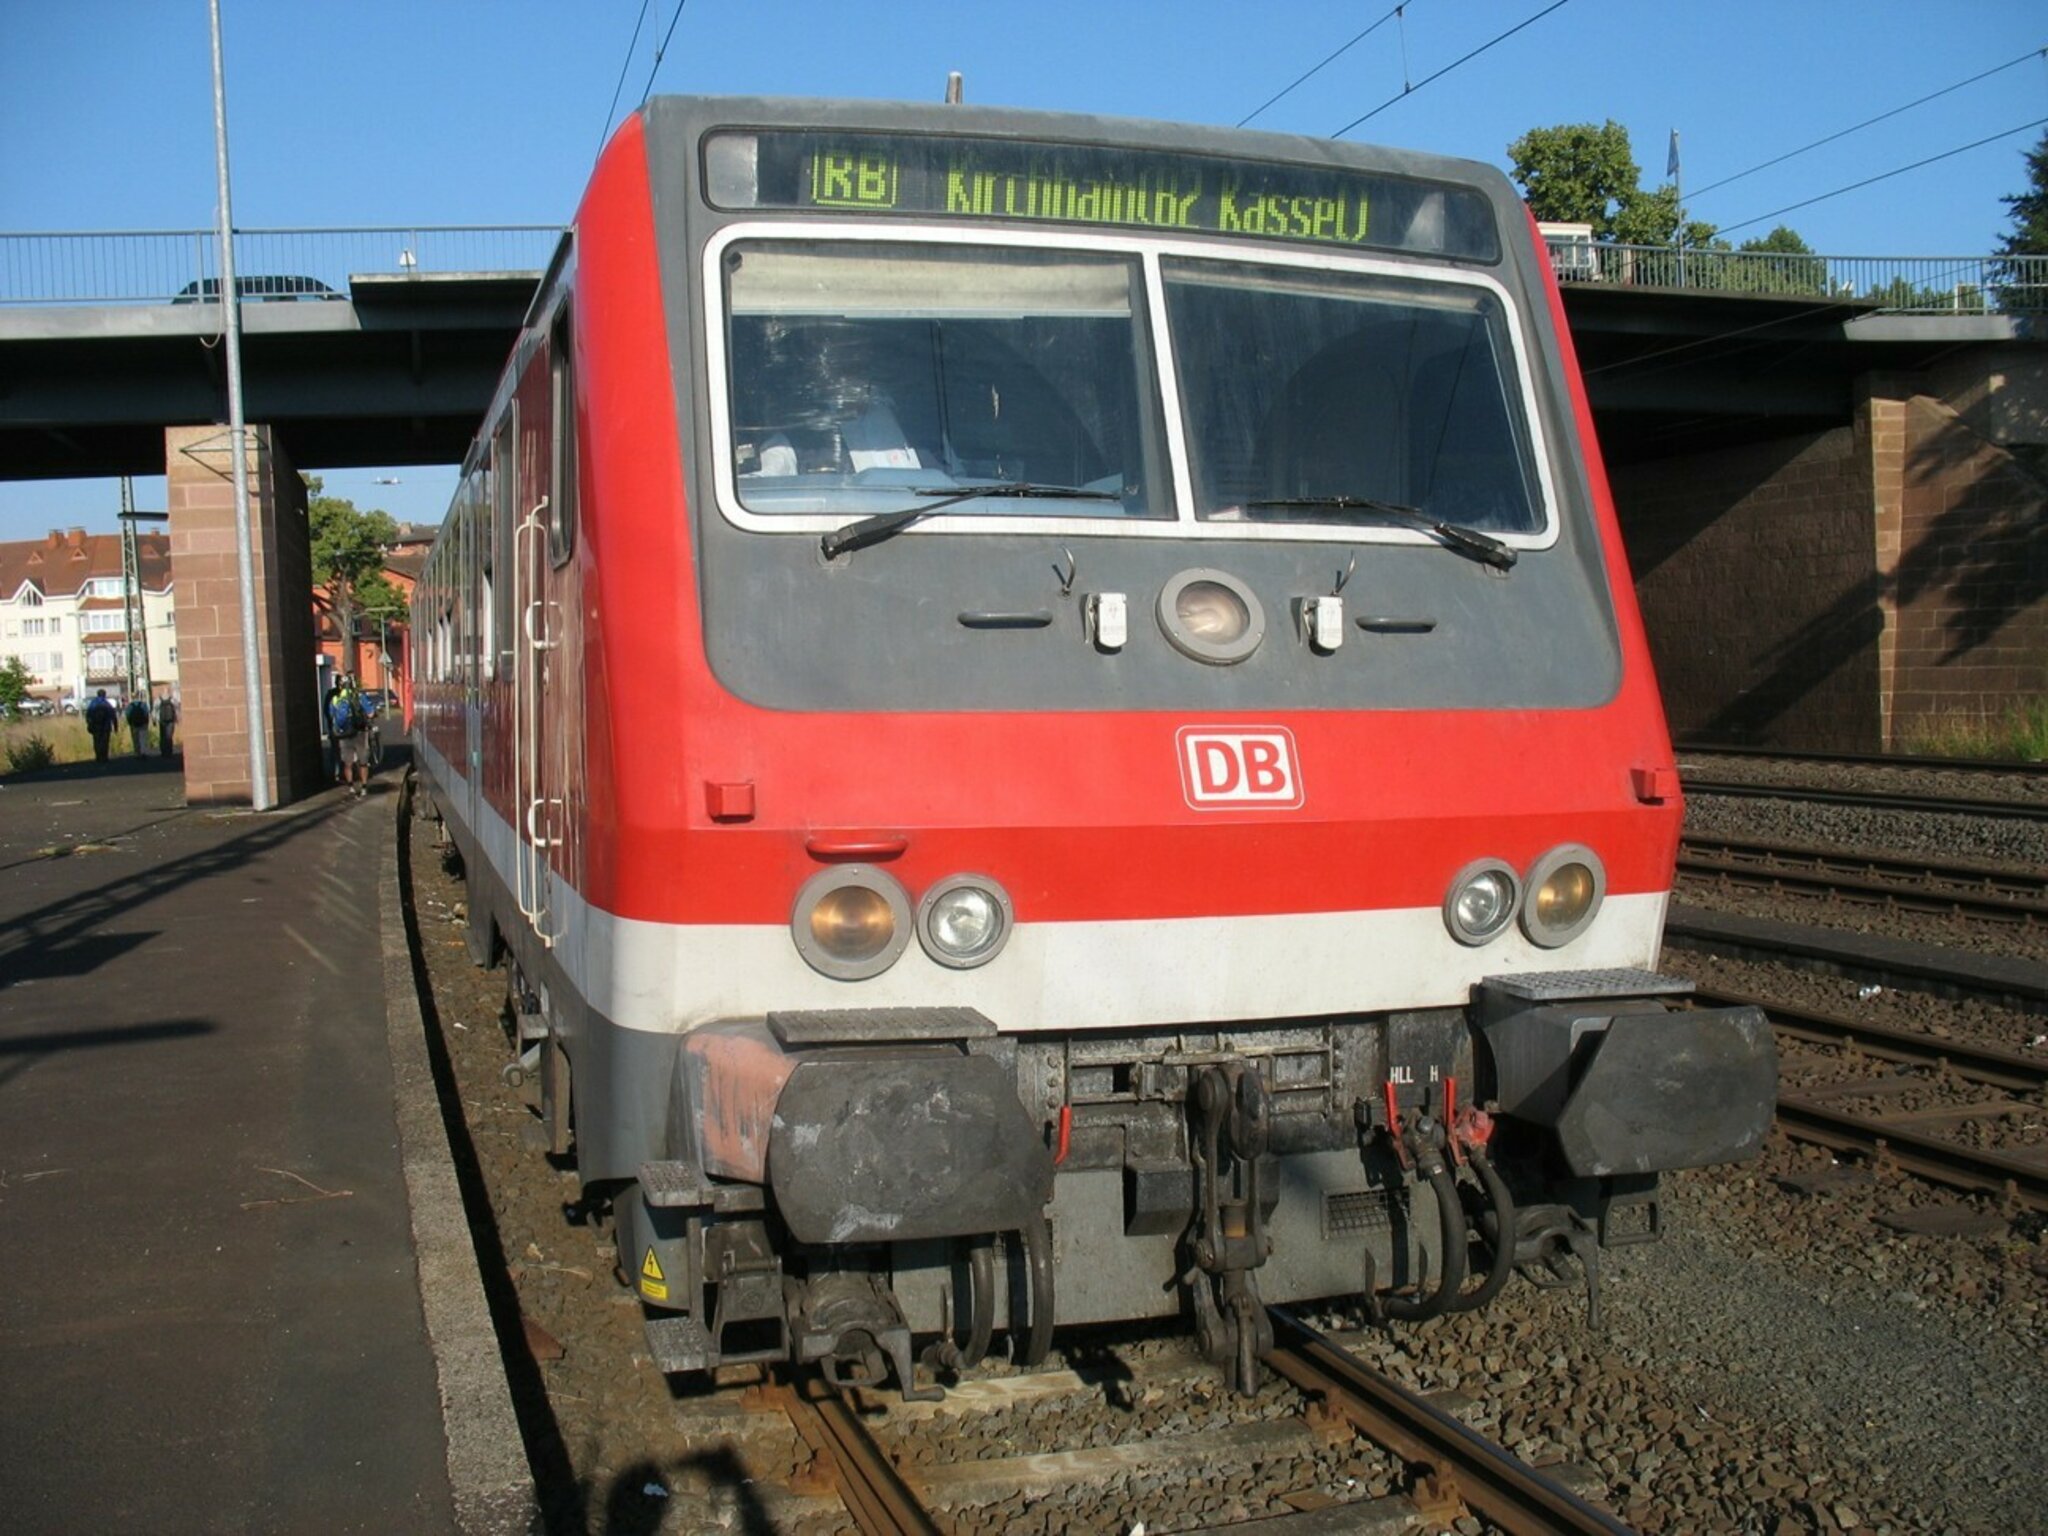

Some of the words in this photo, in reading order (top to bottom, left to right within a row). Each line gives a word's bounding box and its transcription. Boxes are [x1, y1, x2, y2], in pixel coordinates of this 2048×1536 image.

[822, 153, 887, 200] RB
[1193, 739, 1287, 795] DB
[1389, 1066, 1415, 1084] HLL
[1429, 1065, 1439, 1082] H
